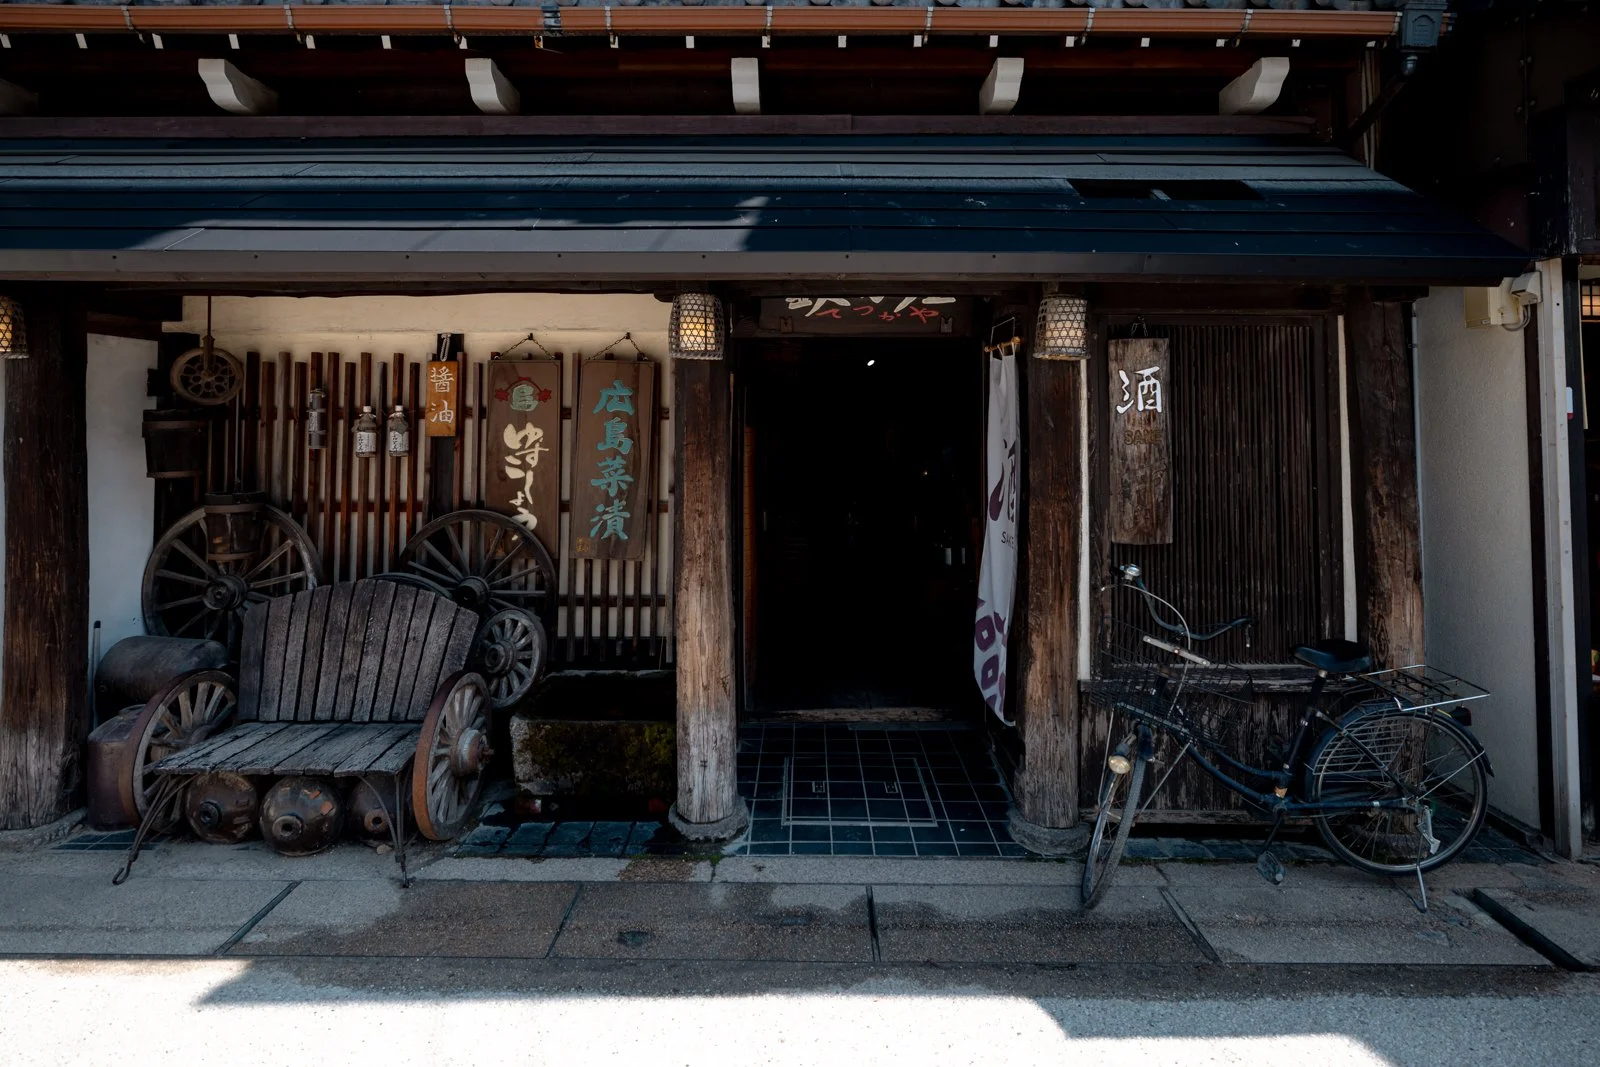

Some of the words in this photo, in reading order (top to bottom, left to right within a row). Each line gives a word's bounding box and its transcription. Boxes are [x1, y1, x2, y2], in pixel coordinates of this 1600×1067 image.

[1116, 366, 1163, 414] 酒
[590, 379, 635, 541] 広島菜漬
[1123, 428, 1161, 446] SAKE
